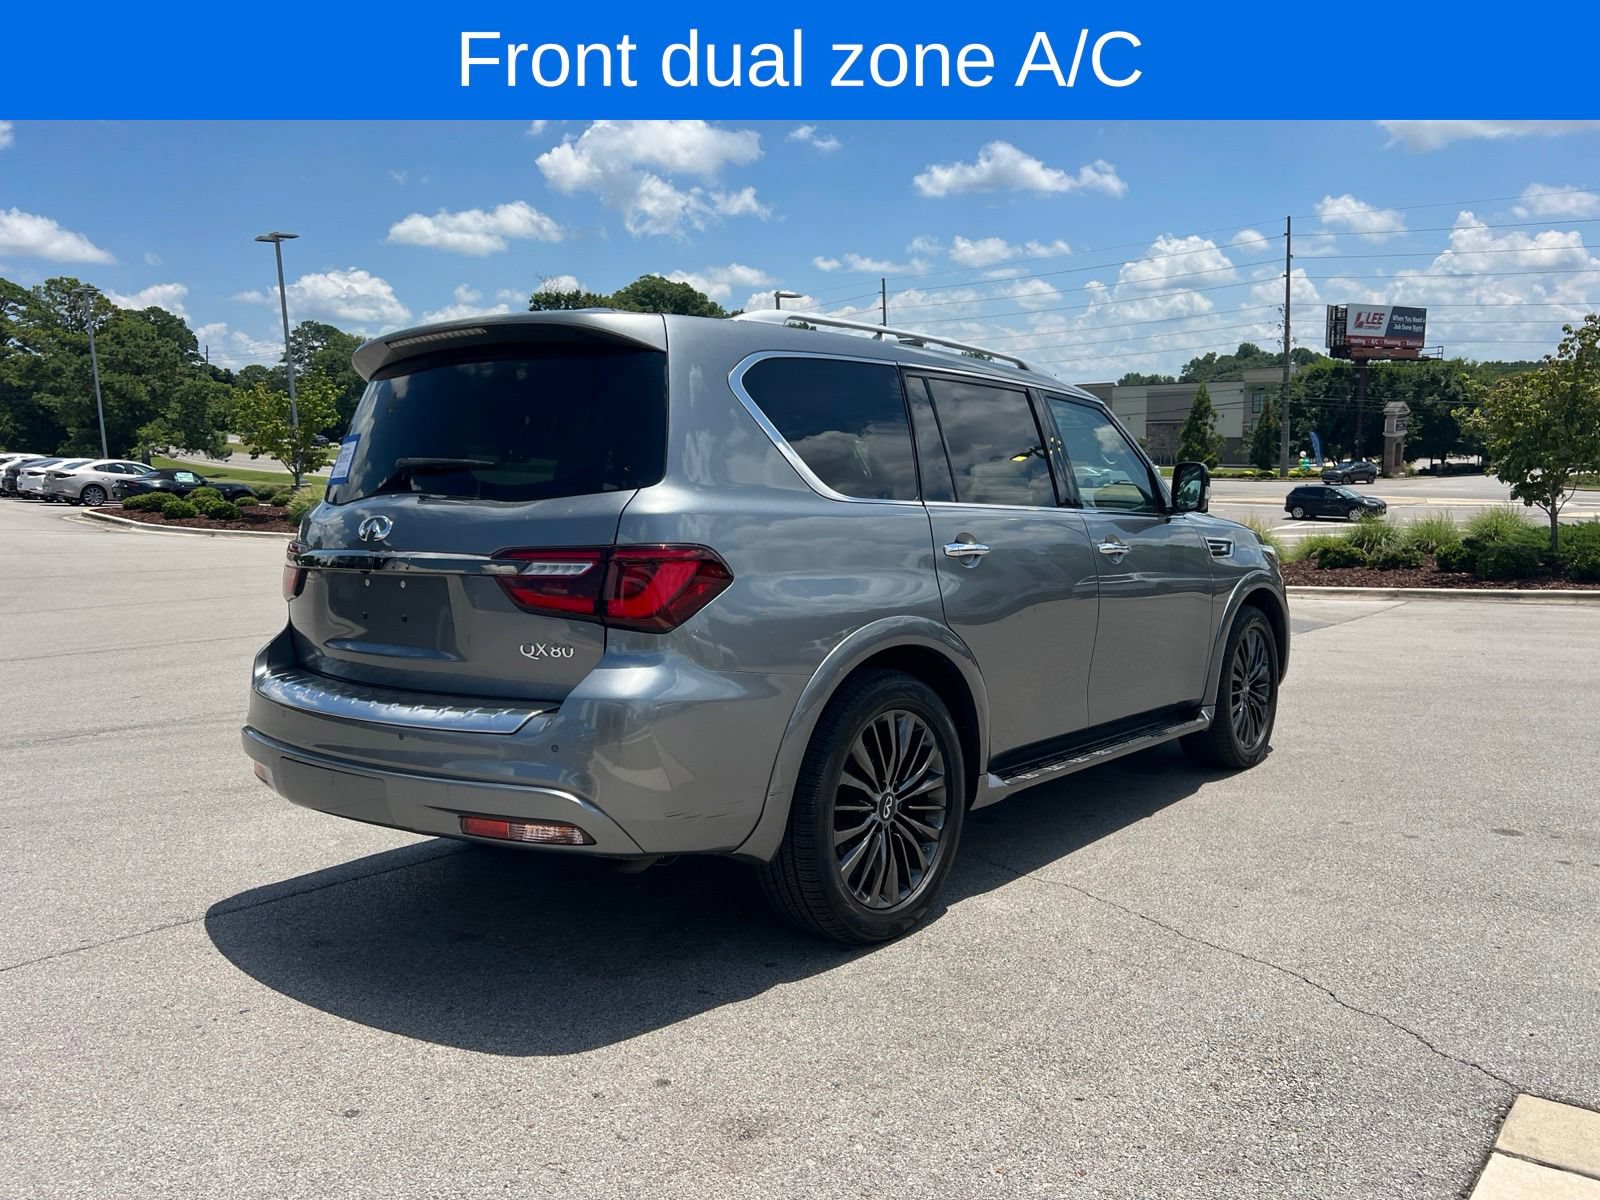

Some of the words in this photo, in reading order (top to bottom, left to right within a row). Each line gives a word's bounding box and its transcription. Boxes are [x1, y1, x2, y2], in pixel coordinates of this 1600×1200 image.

[1366, 312, 1385, 325] LEE
[1392, 314, 1404, 322] When
[1404, 315, 1412, 323] You
[1402, 323, 1412, 331] Done
[519, 642, 575, 660] QX80
